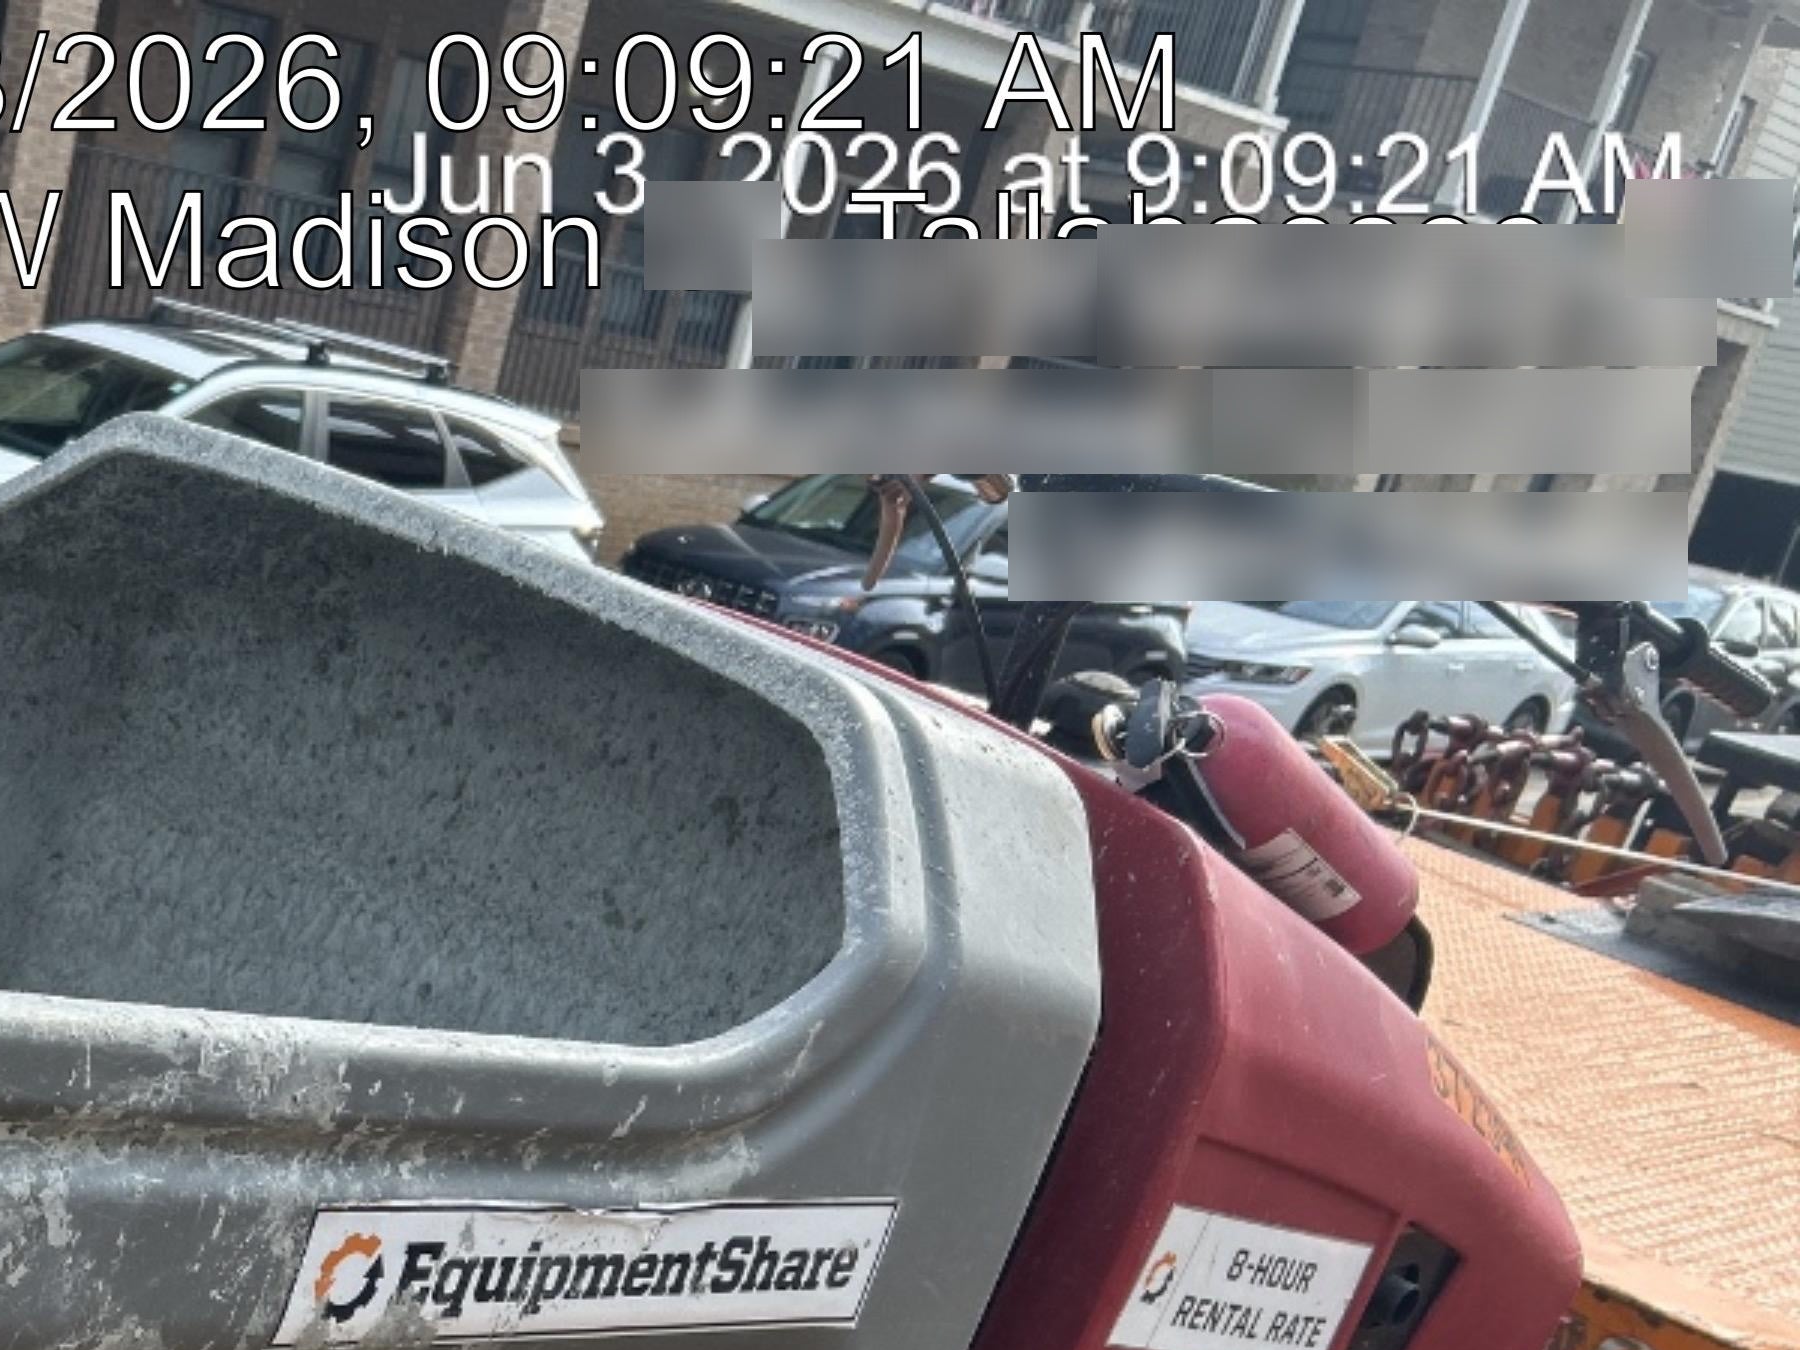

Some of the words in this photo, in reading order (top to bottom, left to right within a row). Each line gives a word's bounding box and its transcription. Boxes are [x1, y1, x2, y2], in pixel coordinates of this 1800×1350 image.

[398, 1235, 859, 1318] EquipmentShare
[1170, 1295, 1264, 1340] RENTAL
[1263, 1310, 1327, 1348] RATE
